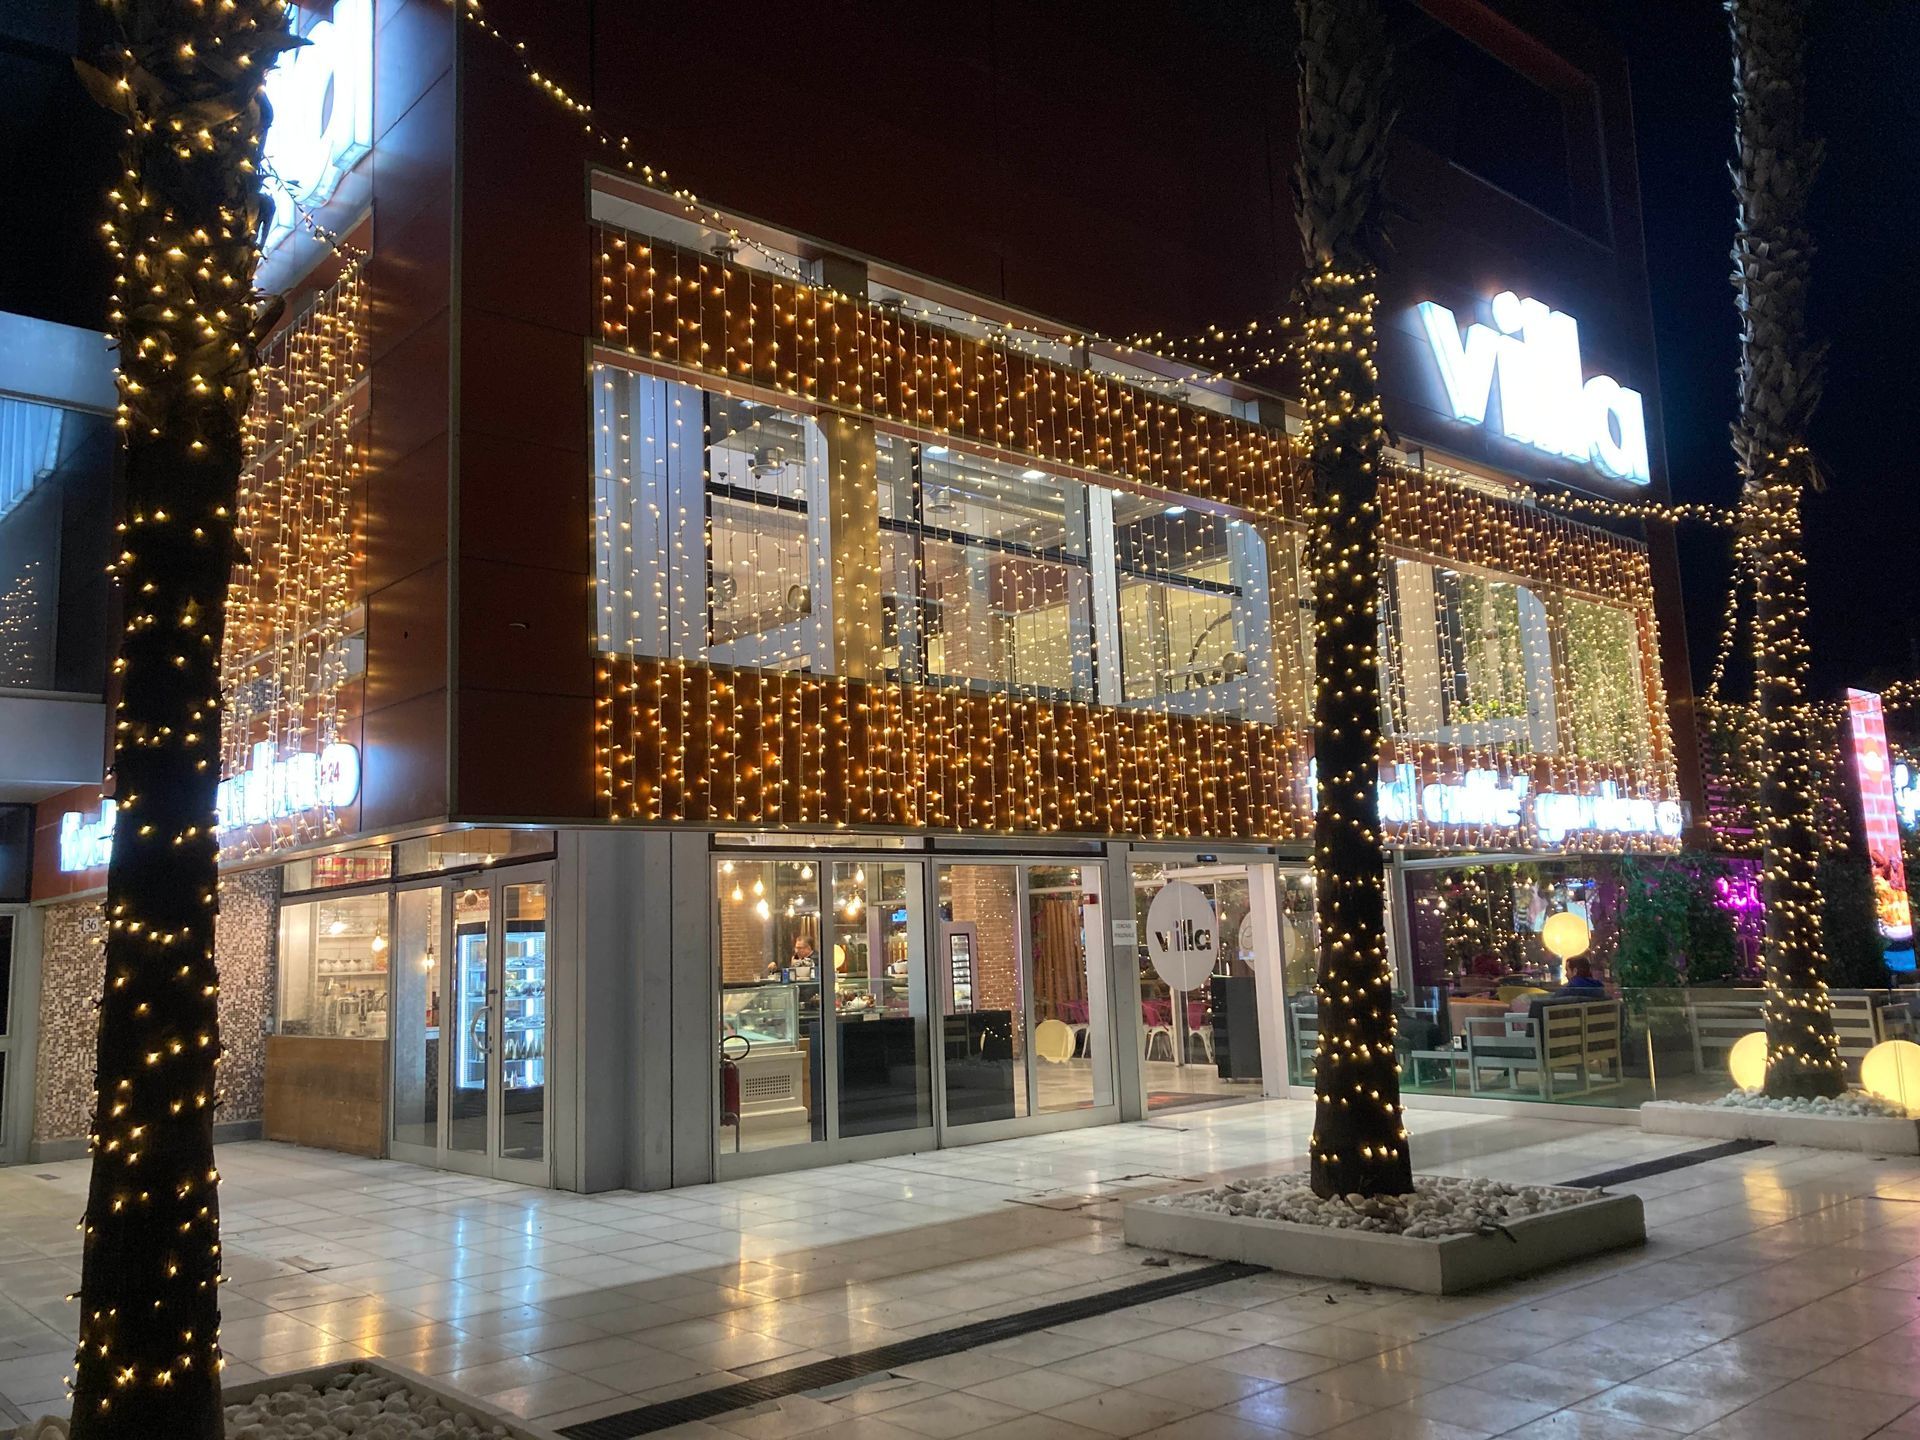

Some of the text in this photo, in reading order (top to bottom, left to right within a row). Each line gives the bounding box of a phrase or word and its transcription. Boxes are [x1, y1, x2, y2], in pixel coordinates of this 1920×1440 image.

[1419, 291, 1650, 485] villa
[85, 919, 97, 931] 36
[1155, 919, 1211, 952] villa
